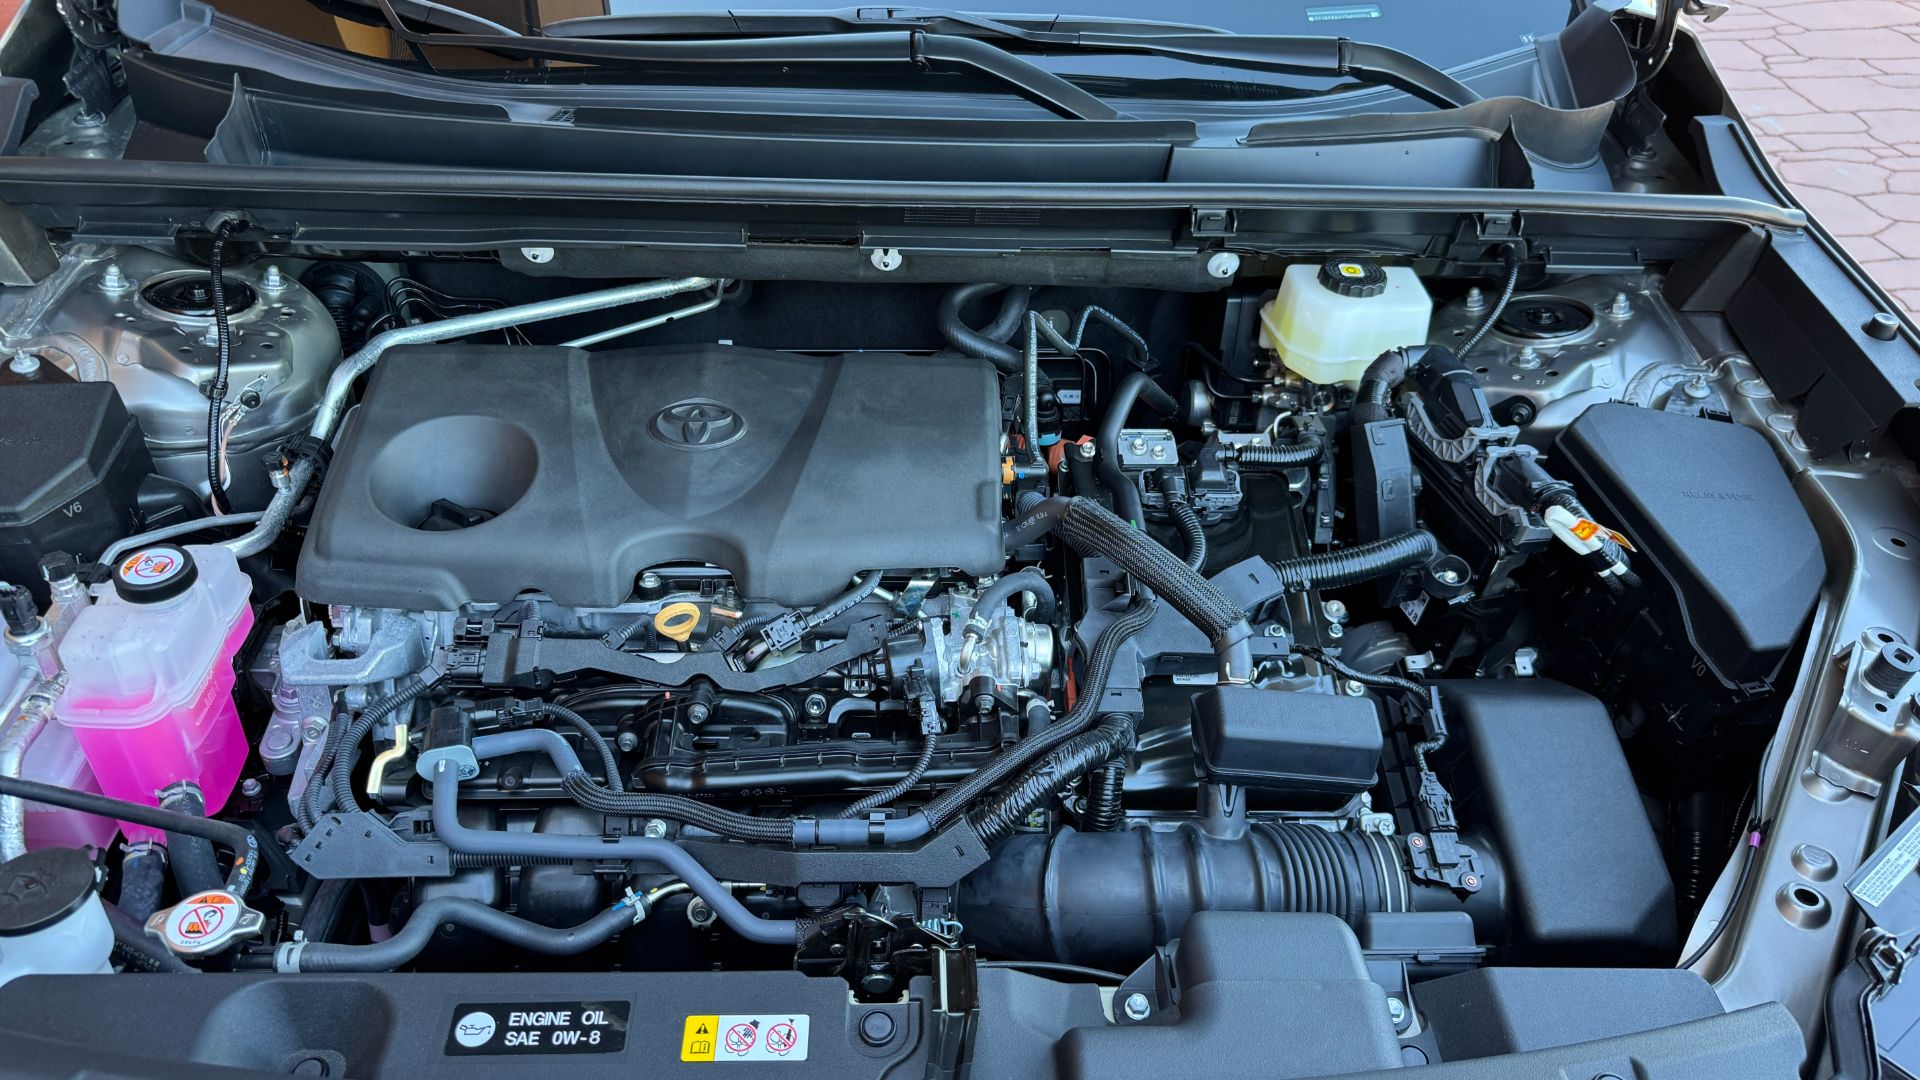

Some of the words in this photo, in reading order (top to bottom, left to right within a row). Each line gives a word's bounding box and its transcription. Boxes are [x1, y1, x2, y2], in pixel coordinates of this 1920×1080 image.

[62, 501, 83, 518] V6
[508, 1011, 572, 1027] ENGINE
[581, 1010, 609, 1026] OIL
[504, 1031, 541, 1047] SAE
[551, 1030, 601, 1046] 0W-8
